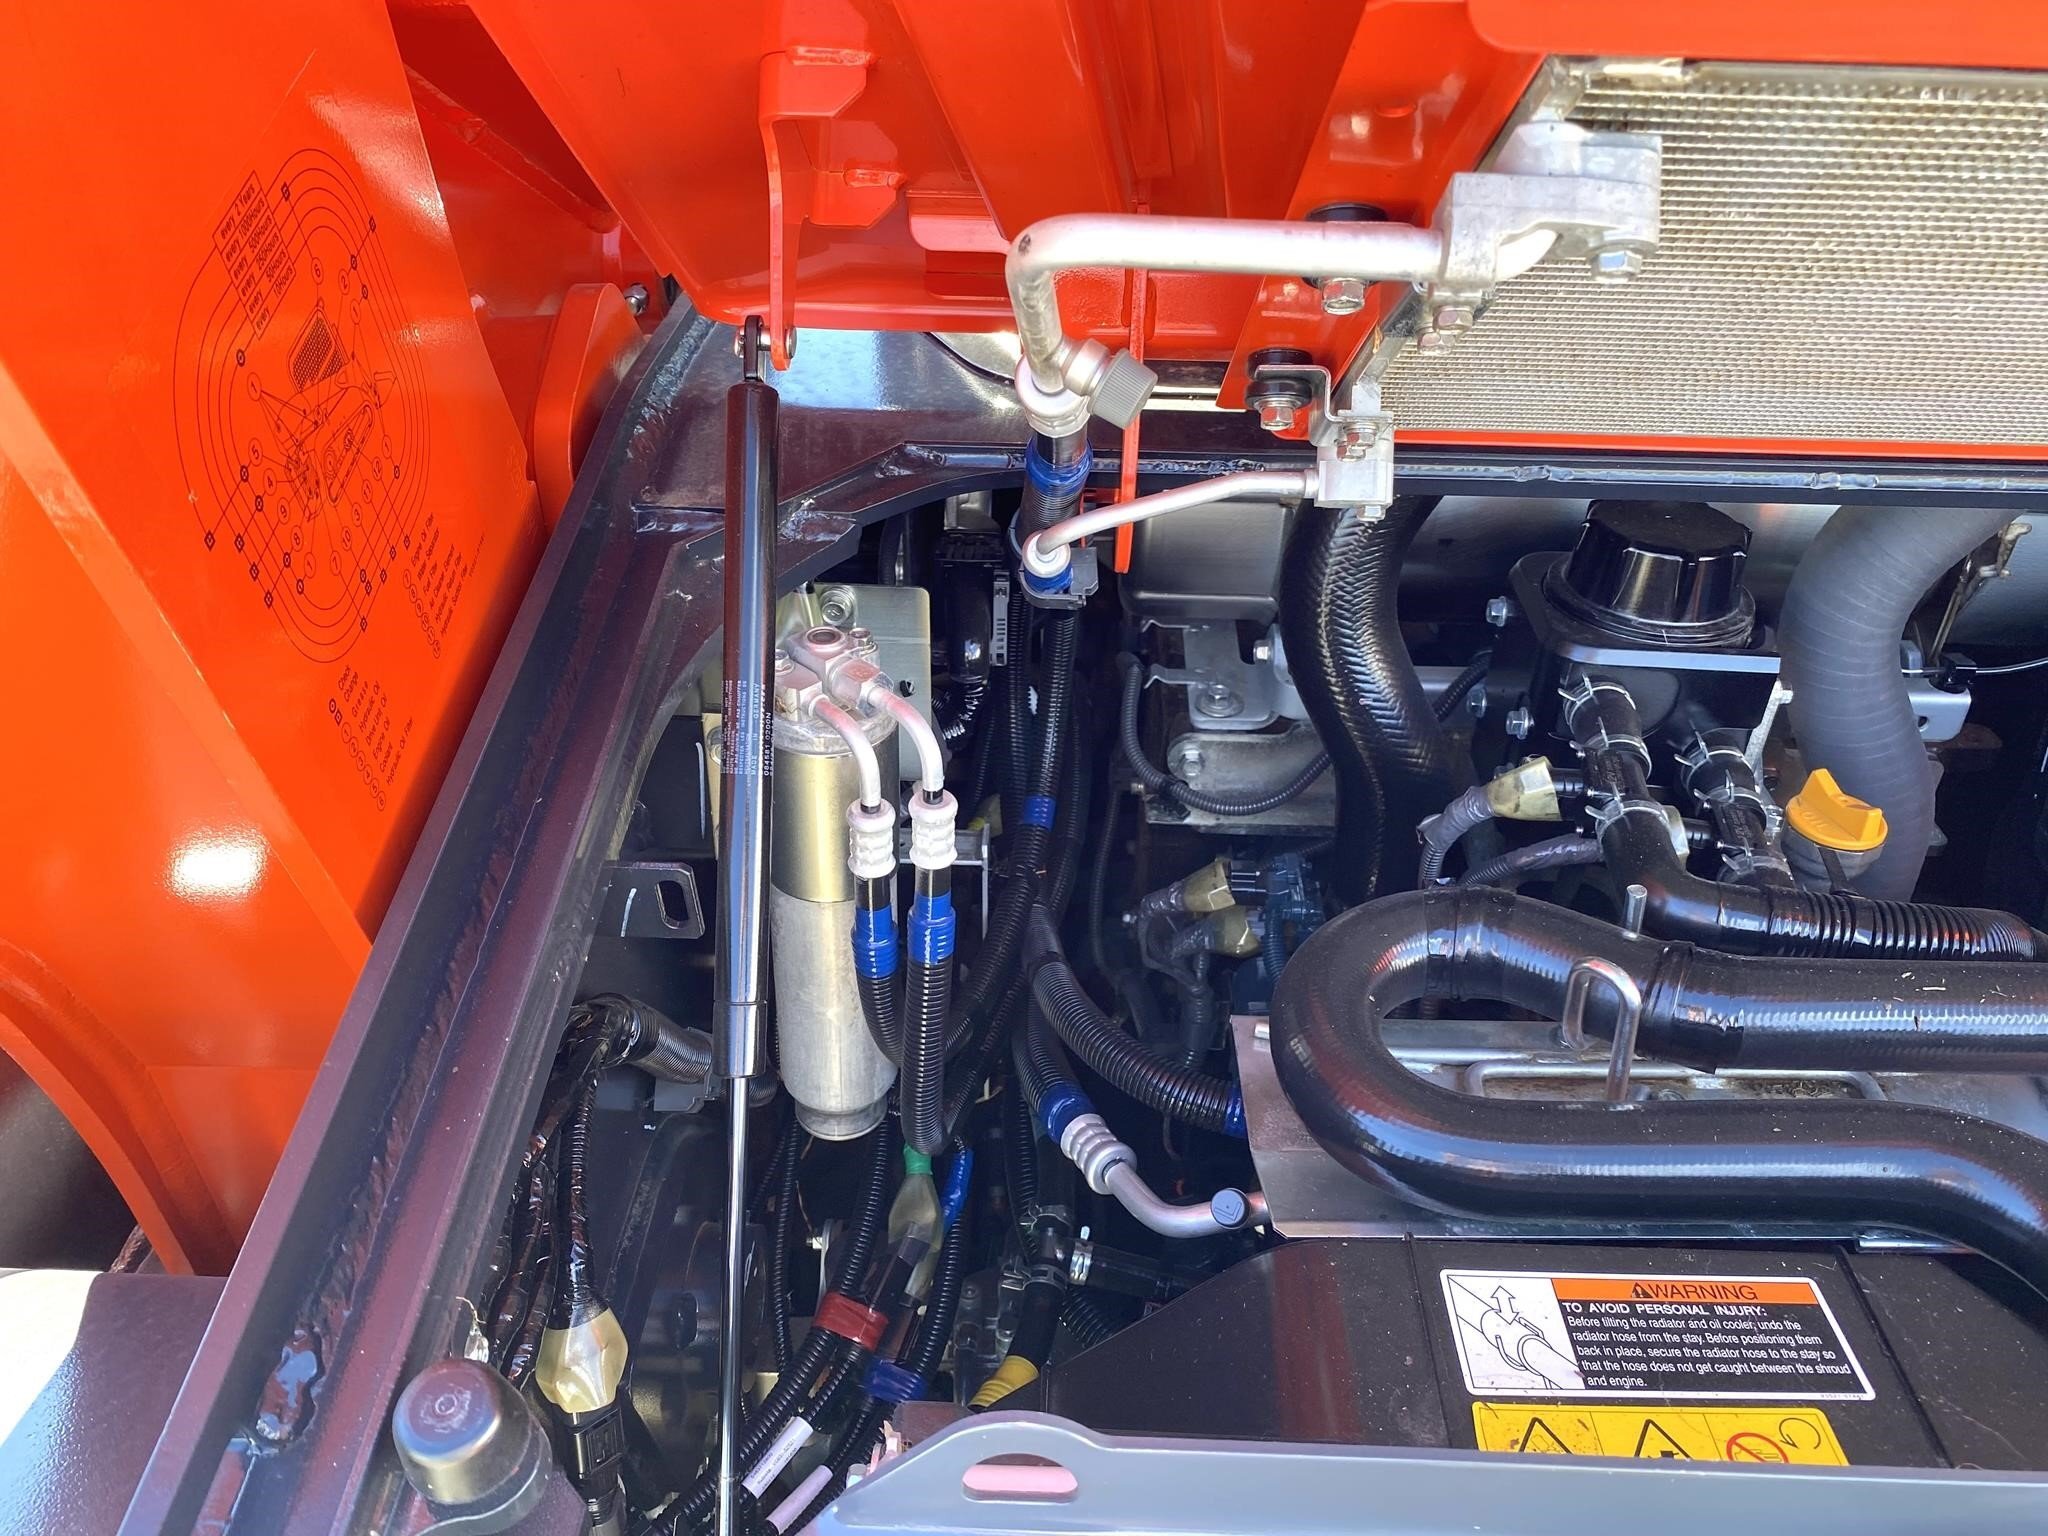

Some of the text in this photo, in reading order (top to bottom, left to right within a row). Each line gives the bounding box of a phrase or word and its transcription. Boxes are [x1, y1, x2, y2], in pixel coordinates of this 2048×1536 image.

[235, 203, 241, 216] 2
[1648, 1284, 1758, 1300] WARNING
[1562, 1303, 1767, 1316] TO AVOID PERSONAL INJURY:
[1567, 1317, 1600, 1327] Before
[1602, 1318, 1629, 1329] tilting
[1630, 1318, 1646, 1327] the
[1648, 1319, 1685, 1328] radiator
[1689, 1319, 1707, 1328] and
[1709, 1320, 1721, 1329] oil
[1758, 1321, 1782, 1330] undo
[1783, 1321, 1801, 1330] the
[1572, 1332, 1822, 1346] radiator hose from the stay. Before positioning them
[1576, 1345, 1836, 1361] back in place, secure the radiator hose to the stay so
[1582, 1361, 1851, 1375] that the hose does not get caught between the shroud
[1587, 1375, 1647, 1388] and engine.
